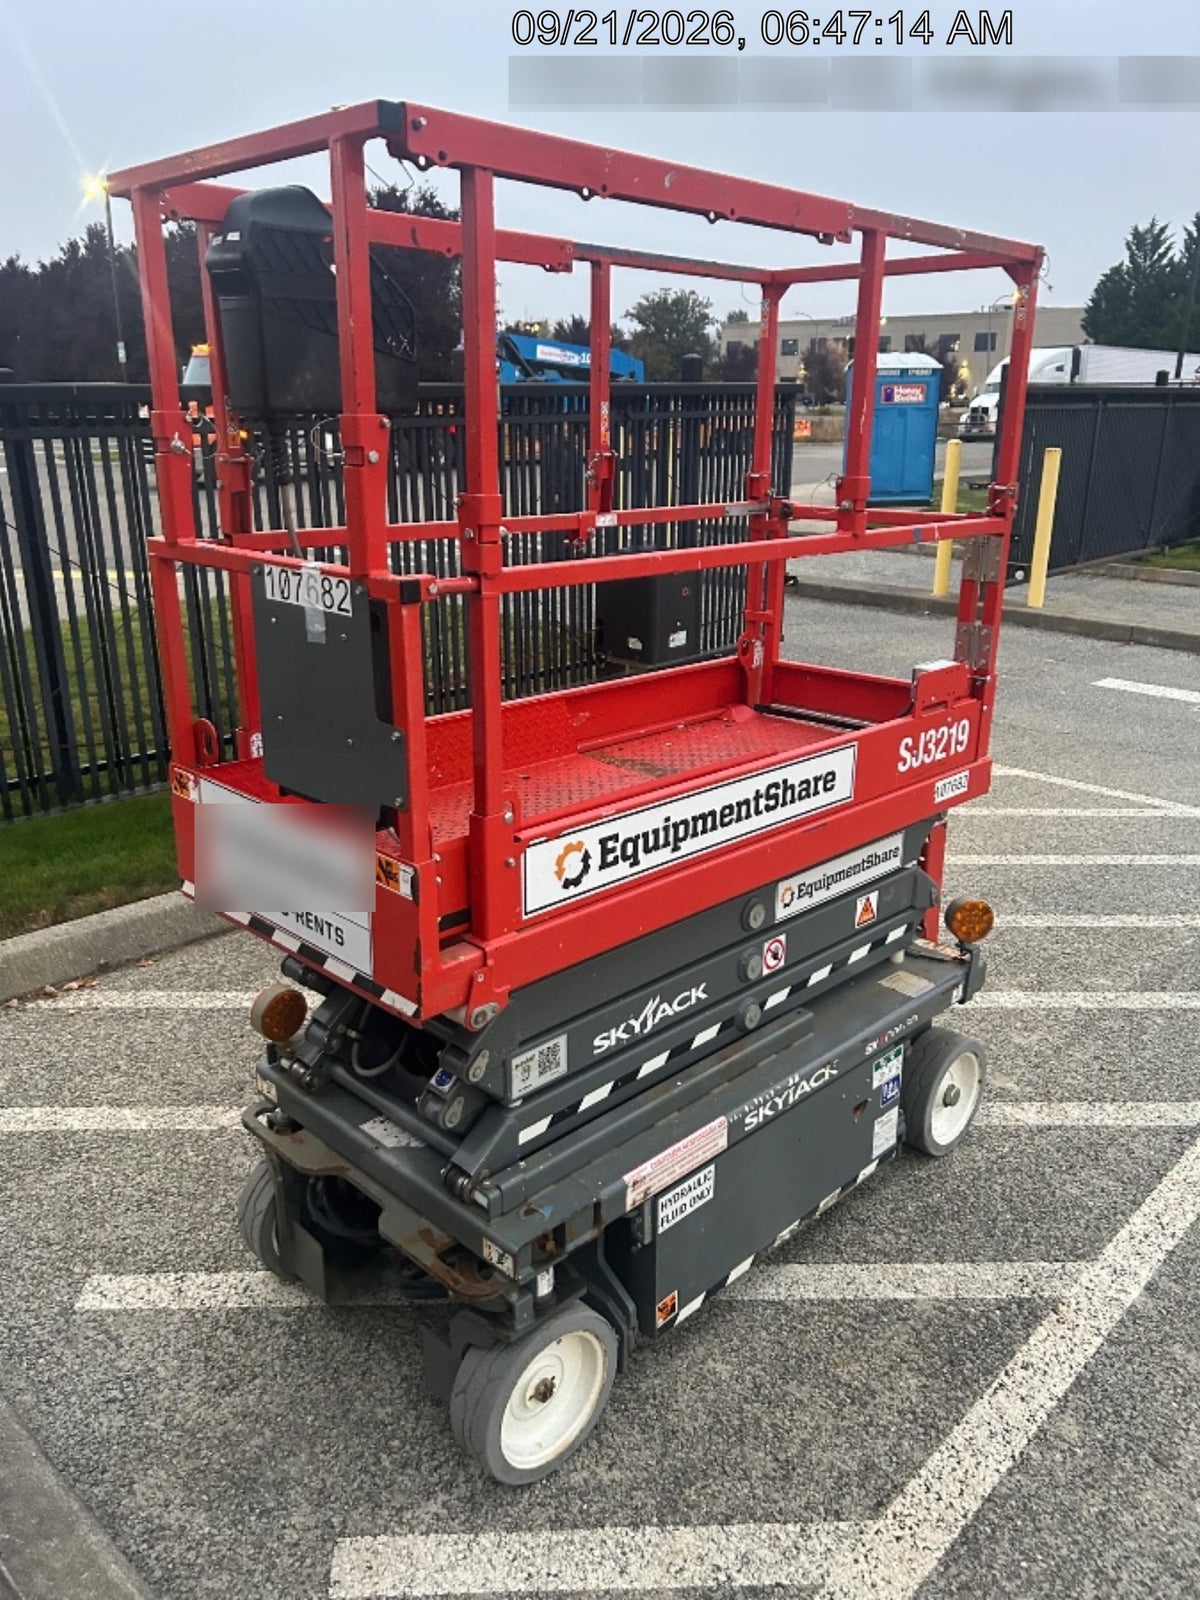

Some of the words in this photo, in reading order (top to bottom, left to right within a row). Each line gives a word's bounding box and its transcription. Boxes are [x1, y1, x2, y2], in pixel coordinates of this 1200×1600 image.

[266, 566, 350, 614] 107682
[897, 718, 970, 773] SJ3219
[598, 768, 837, 872] EquipmentShare
[796, 846, 900, 900] EquipmentShare
[281, 912, 344, 946] -RENTS
[593, 981, 709, 1055] SKYJACK
[744, 1064, 839, 1132] SKYJACK
[660, 1168, 713, 1213] HYDRAULIC
[660, 1201, 688, 1228] FLUID
[689, 1184, 713, 1209] ONLY
